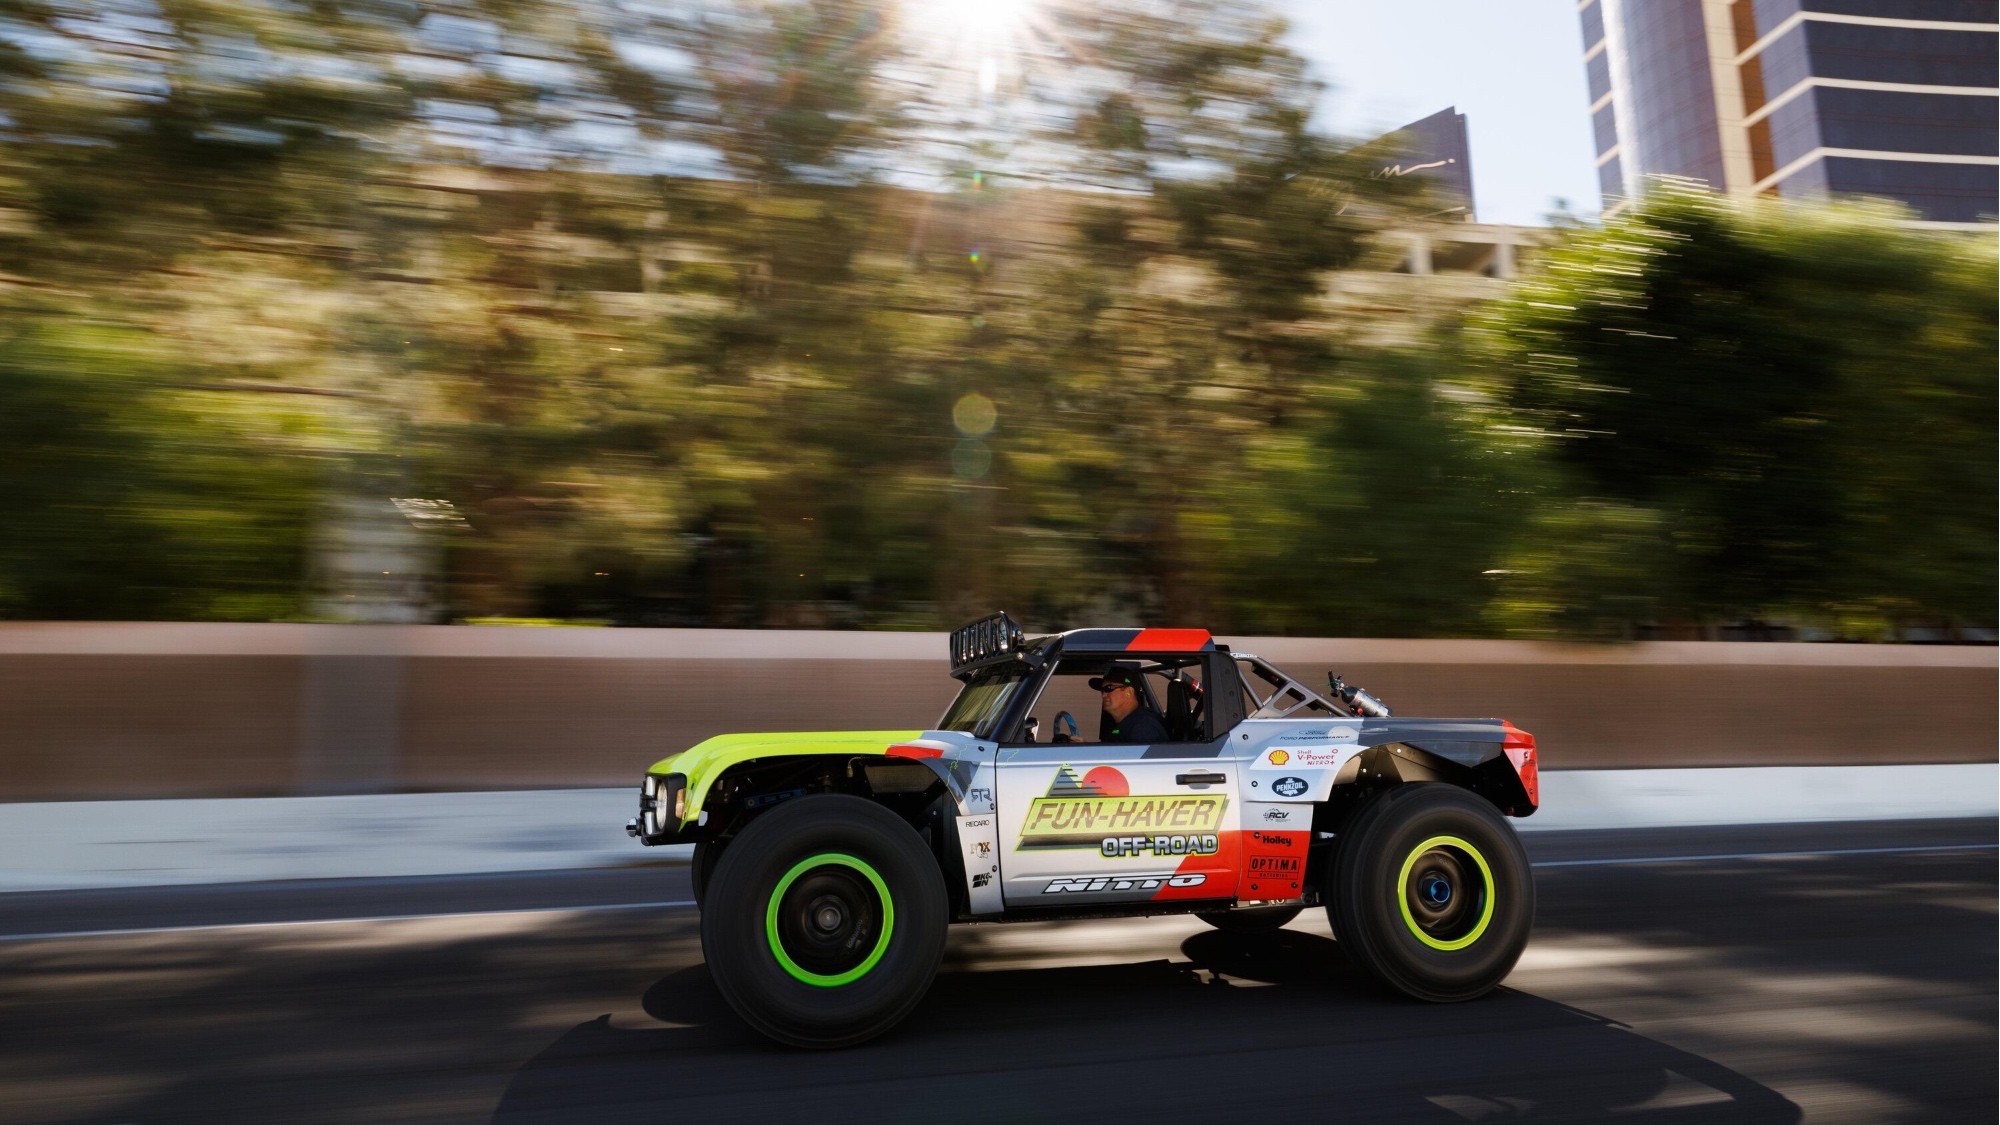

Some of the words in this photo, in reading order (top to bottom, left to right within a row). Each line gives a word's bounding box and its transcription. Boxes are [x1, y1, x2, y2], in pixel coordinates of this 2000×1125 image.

[1276, 782, 1304, 792] PENNZOIL
[1030, 800, 1217, 830] FUN-HAVER
[965, 820, 990, 828] RECARO
[1101, 833, 1218, 858] OFF-ROAD
[1262, 836, 1291, 847] Holley
[1251, 858, 1297, 871] OPTIMA
